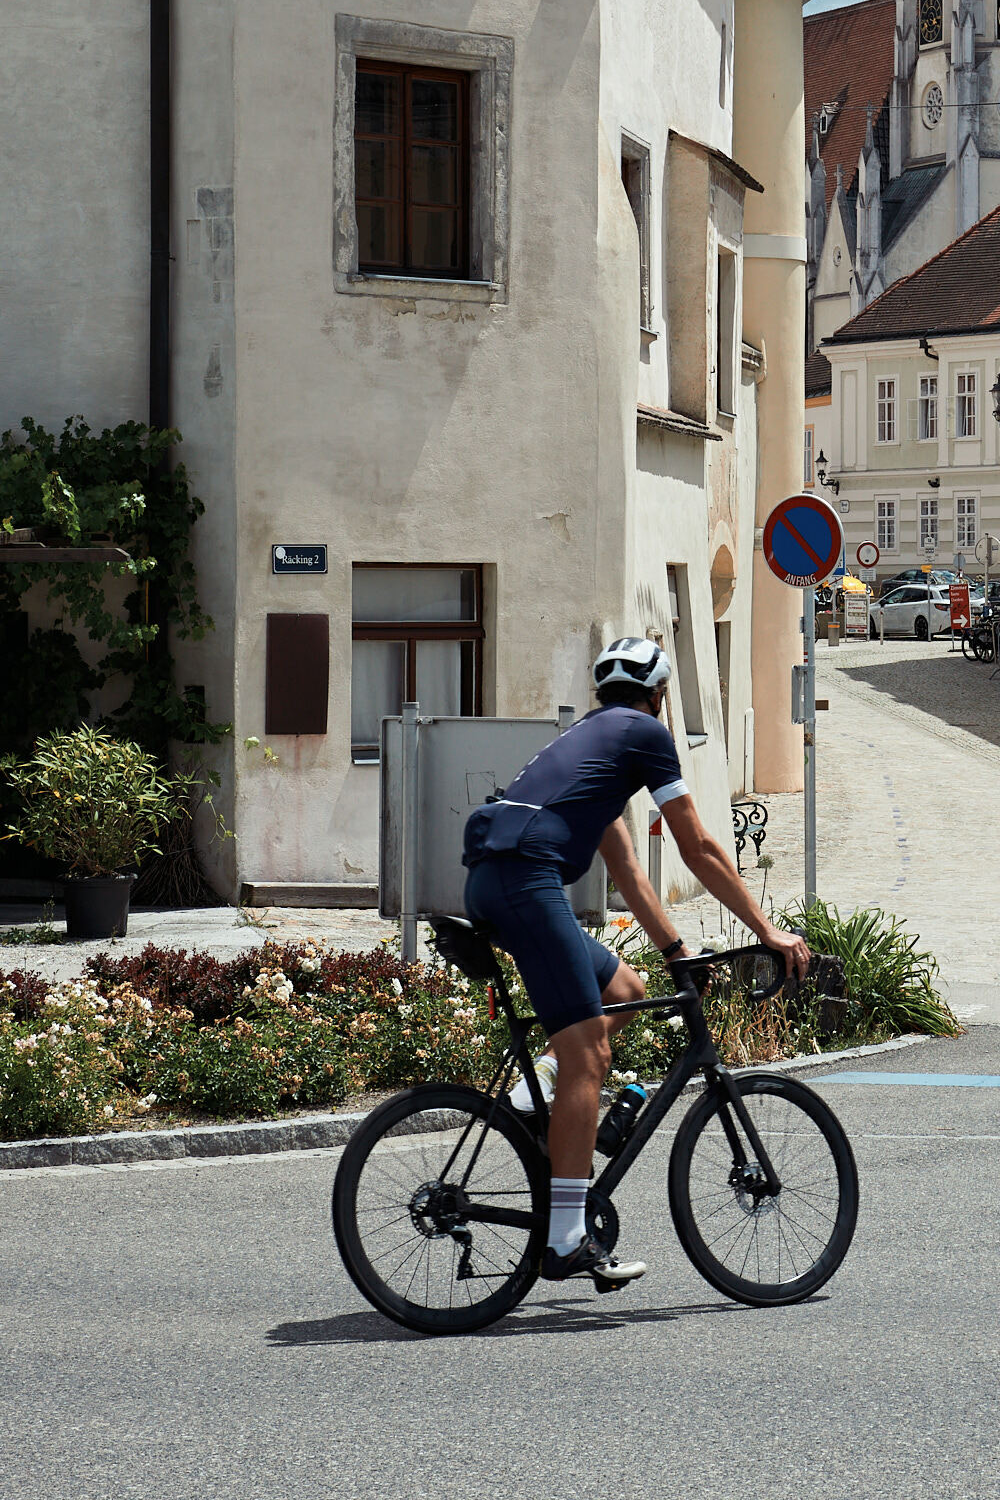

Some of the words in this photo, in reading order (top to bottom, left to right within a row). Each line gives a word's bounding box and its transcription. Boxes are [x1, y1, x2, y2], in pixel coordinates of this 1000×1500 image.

[282, 554, 313, 566] Räcking
[314, 554, 319, 564] 2
[784, 573, 817, 586] ANFANG
